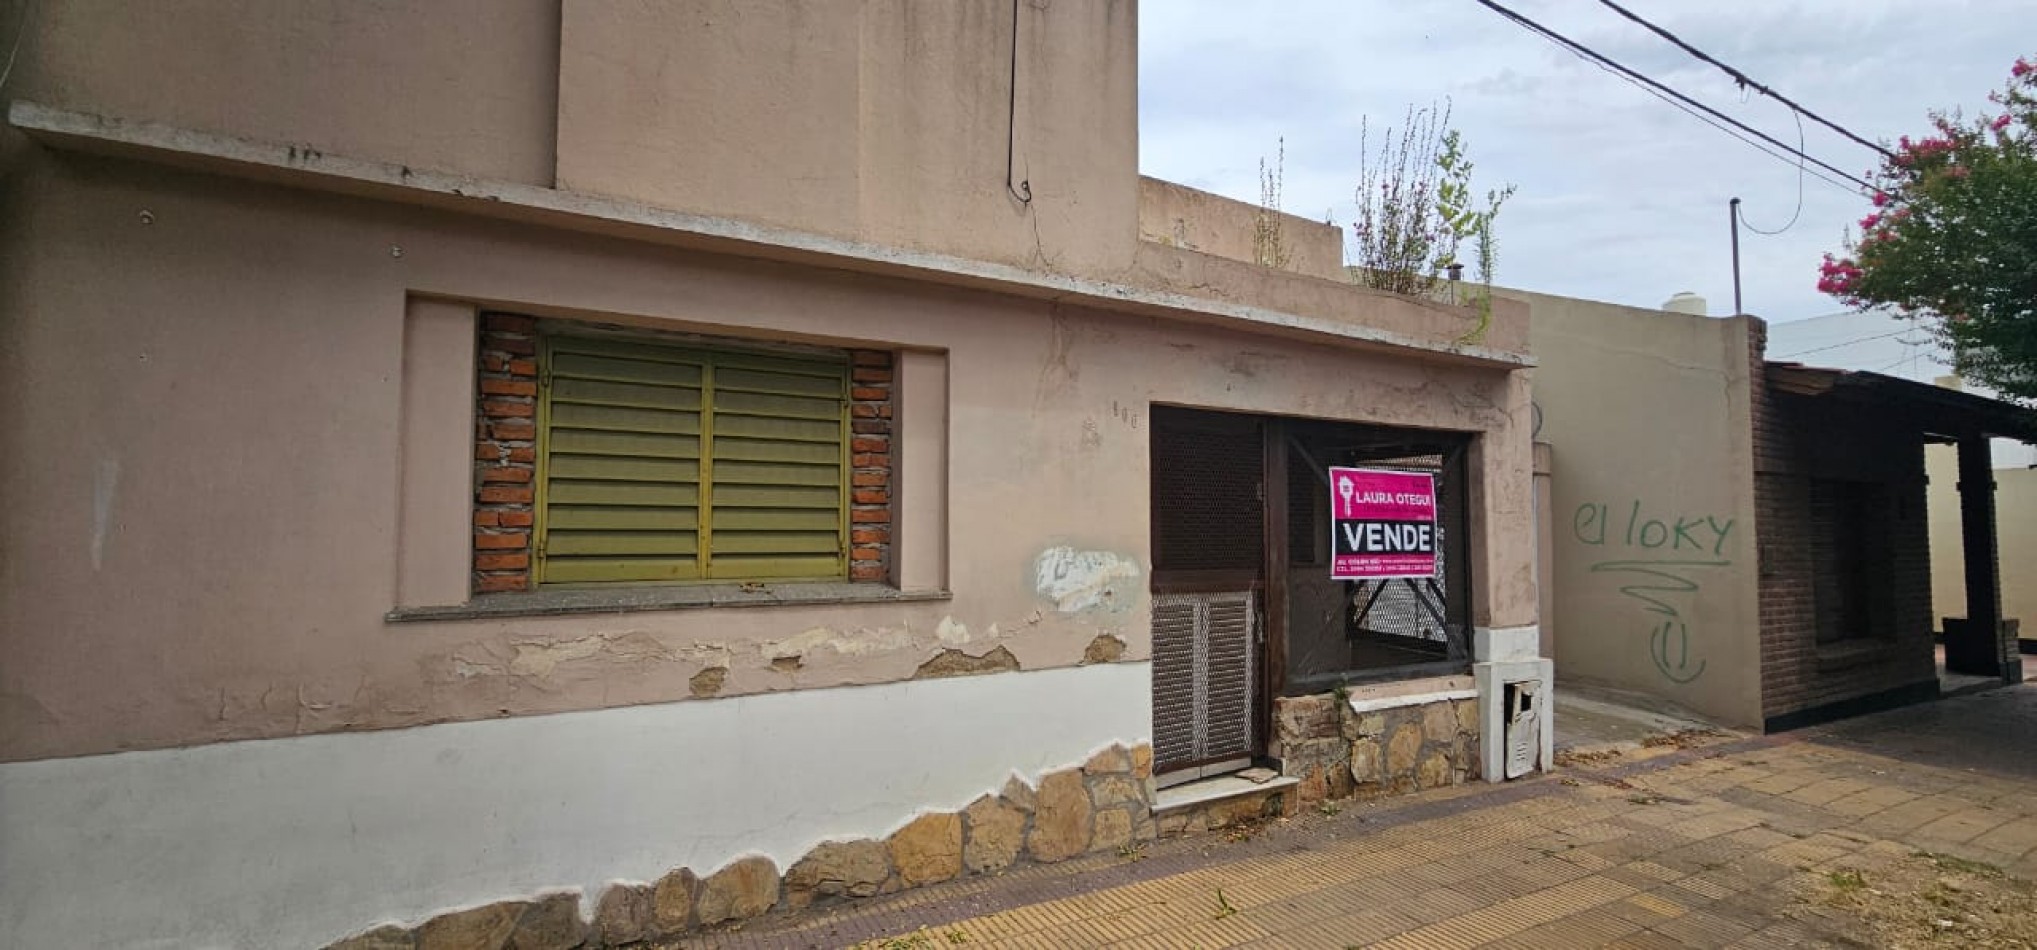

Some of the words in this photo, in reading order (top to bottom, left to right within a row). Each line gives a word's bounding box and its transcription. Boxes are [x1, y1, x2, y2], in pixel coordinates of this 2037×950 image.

[1355, 491, 1394, 504] LAURA
[1396, 493, 1431, 506] OTEGUI
[1343, 523, 1431, 552] VENDE
